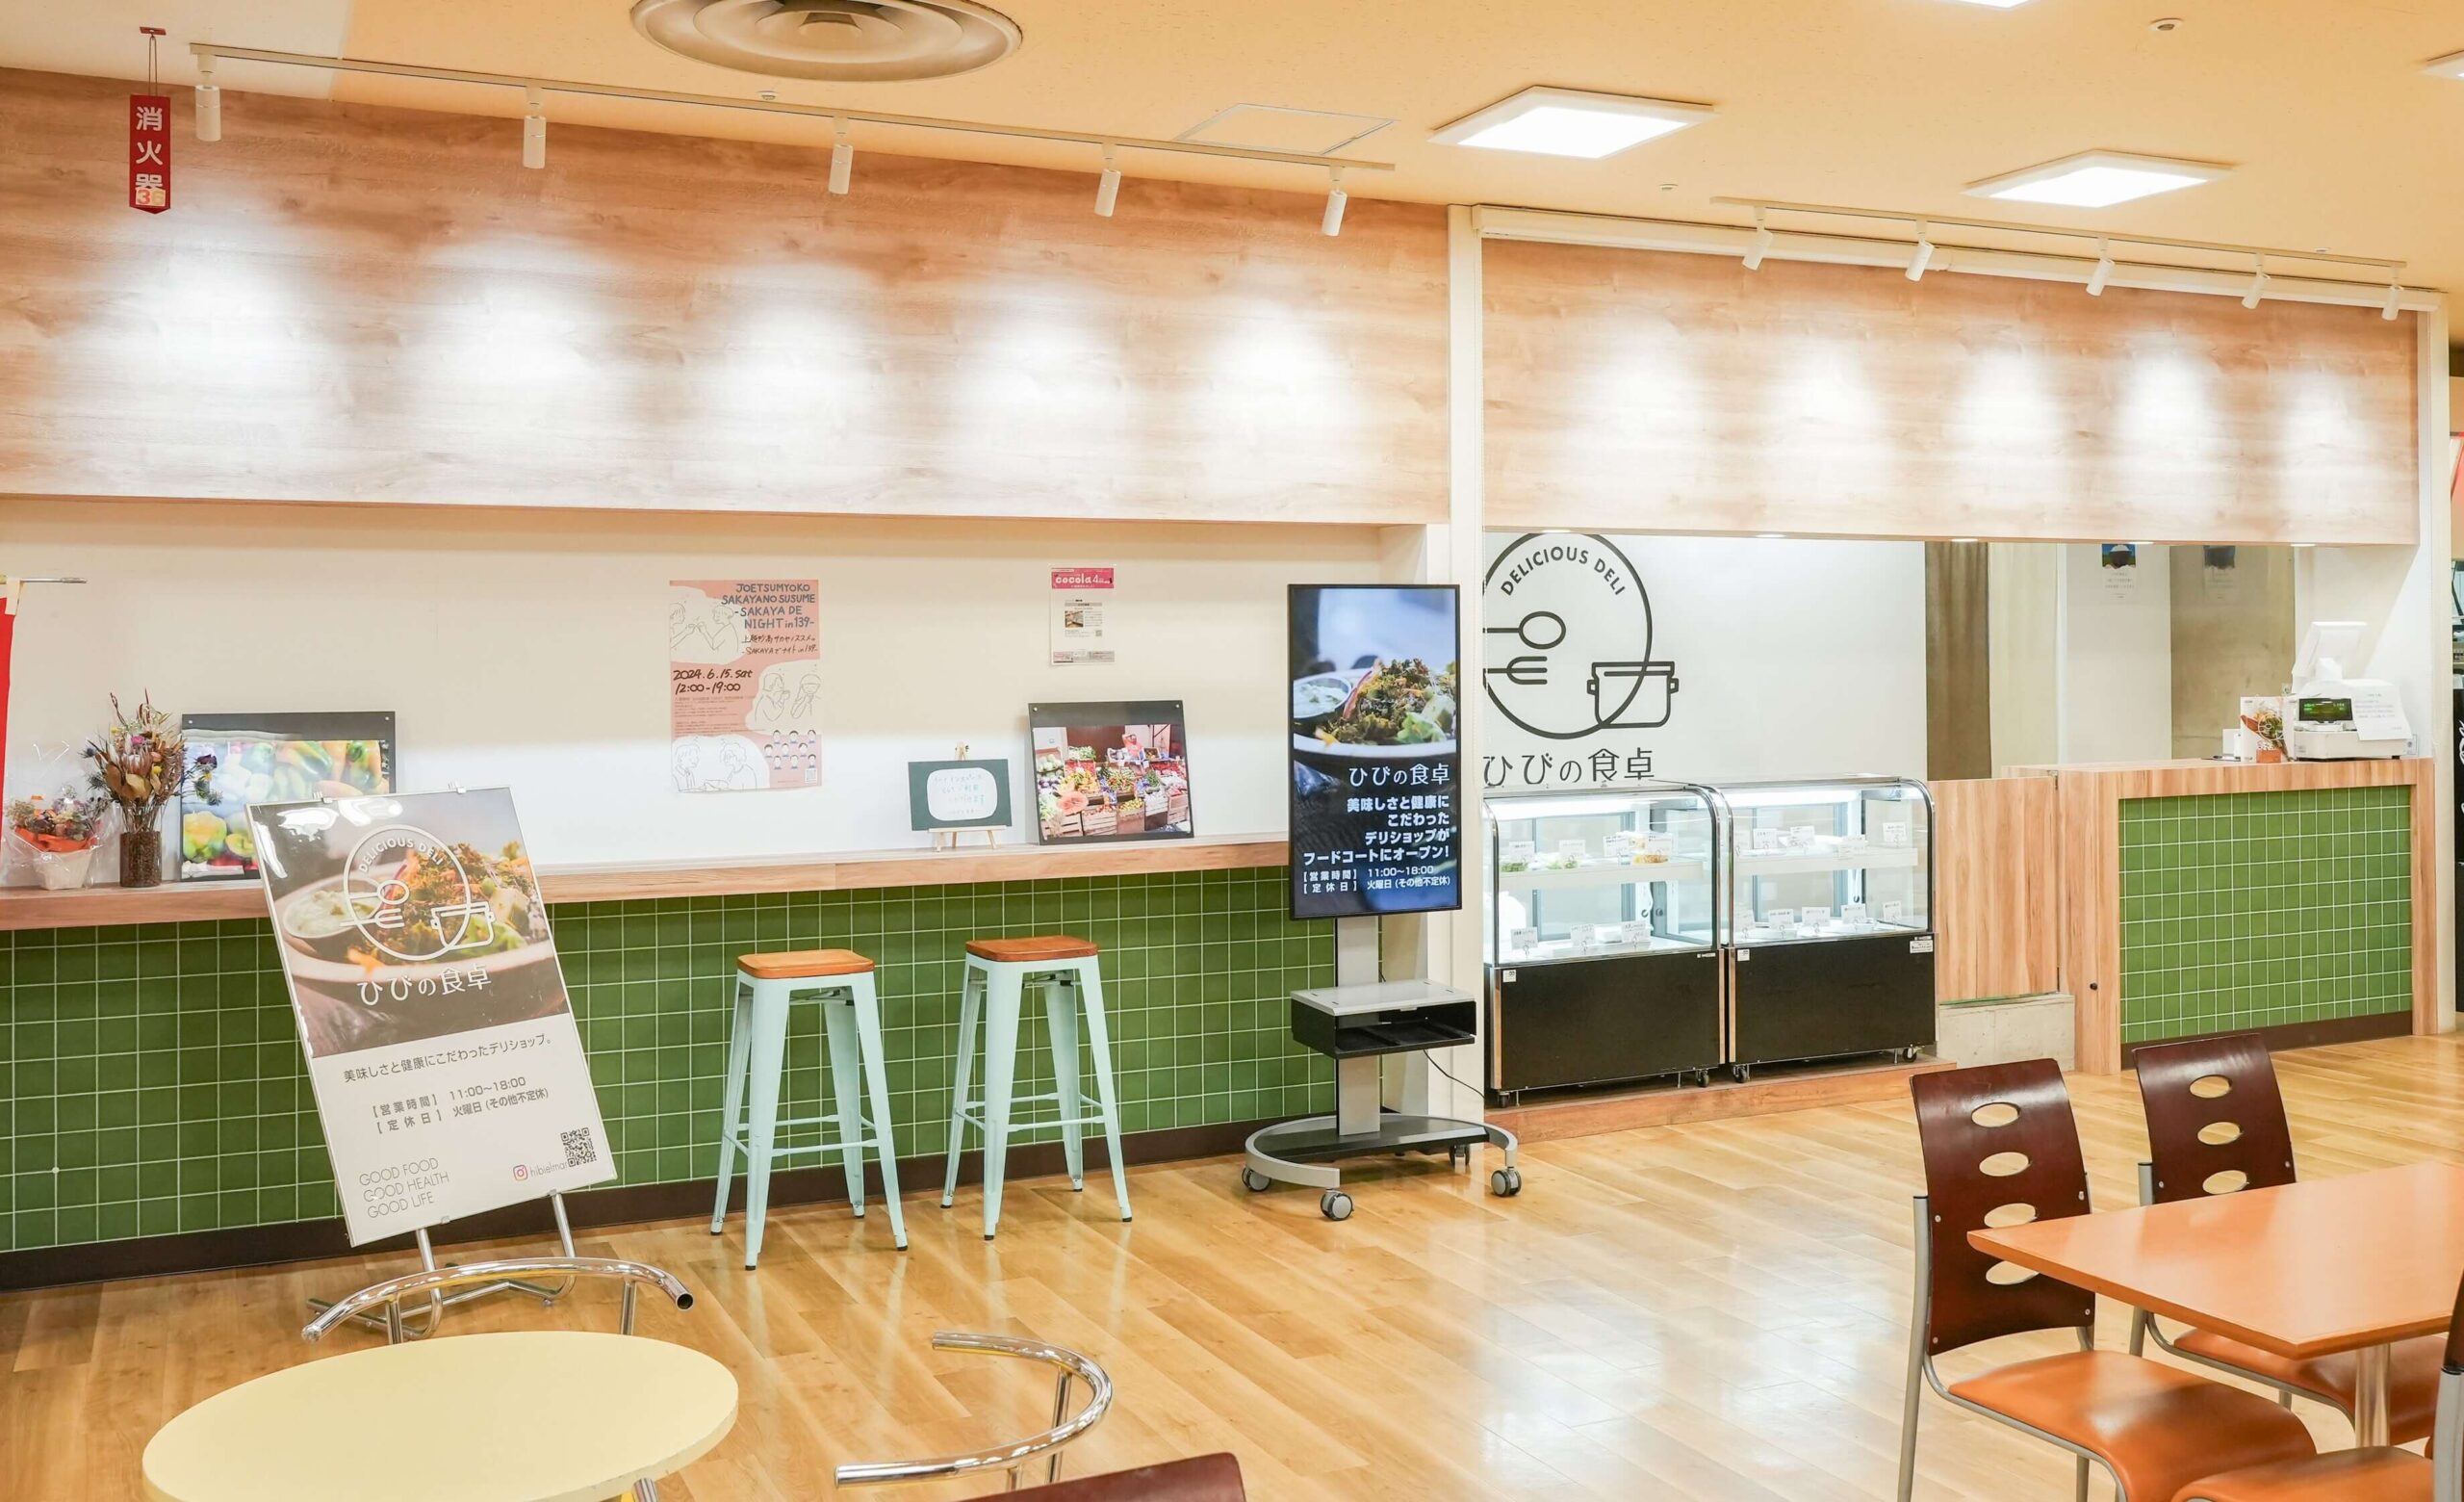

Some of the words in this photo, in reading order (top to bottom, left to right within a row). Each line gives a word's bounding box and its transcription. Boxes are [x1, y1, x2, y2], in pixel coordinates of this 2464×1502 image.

[1501, 546, 1589, 596] DELICIOUS
[1594, 558, 1626, 595] DELI
[721, 594, 777, 605] SAKAYANO
[779, 594, 815, 604] SUSUME
[735, 583, 810, 593] JOETSUMYOKO
[788, 605, 803, 615] DE
[744, 618, 783, 629] NIGHT
[1348, 763, 1450, 787] ひびの食卓
[1483, 747, 1655, 786] ひびの食卓
[1348, 795, 1450, 813] 美味しさと健康に
[1388, 812, 1450, 827] こだわった
[1365, 828, 1450, 845] デリショップが
[358, 837, 414, 872] DELICIOUS
[419, 843, 443, 866] DELI
[357, 963, 492, 1006] ひびの食卓
[344, 1033, 552, 1082] 美味しさと健康にこだわったデリショップ。
[359, 1167, 399, 1185] GOOD
[402, 1157, 439, 1176] FOOD
[364, 1182, 404, 1202] GOOD
[407, 1172, 449, 1192] HEALTH
[368, 1199, 408, 1218] GOOD
[411, 1191, 434, 1207] LIFE
